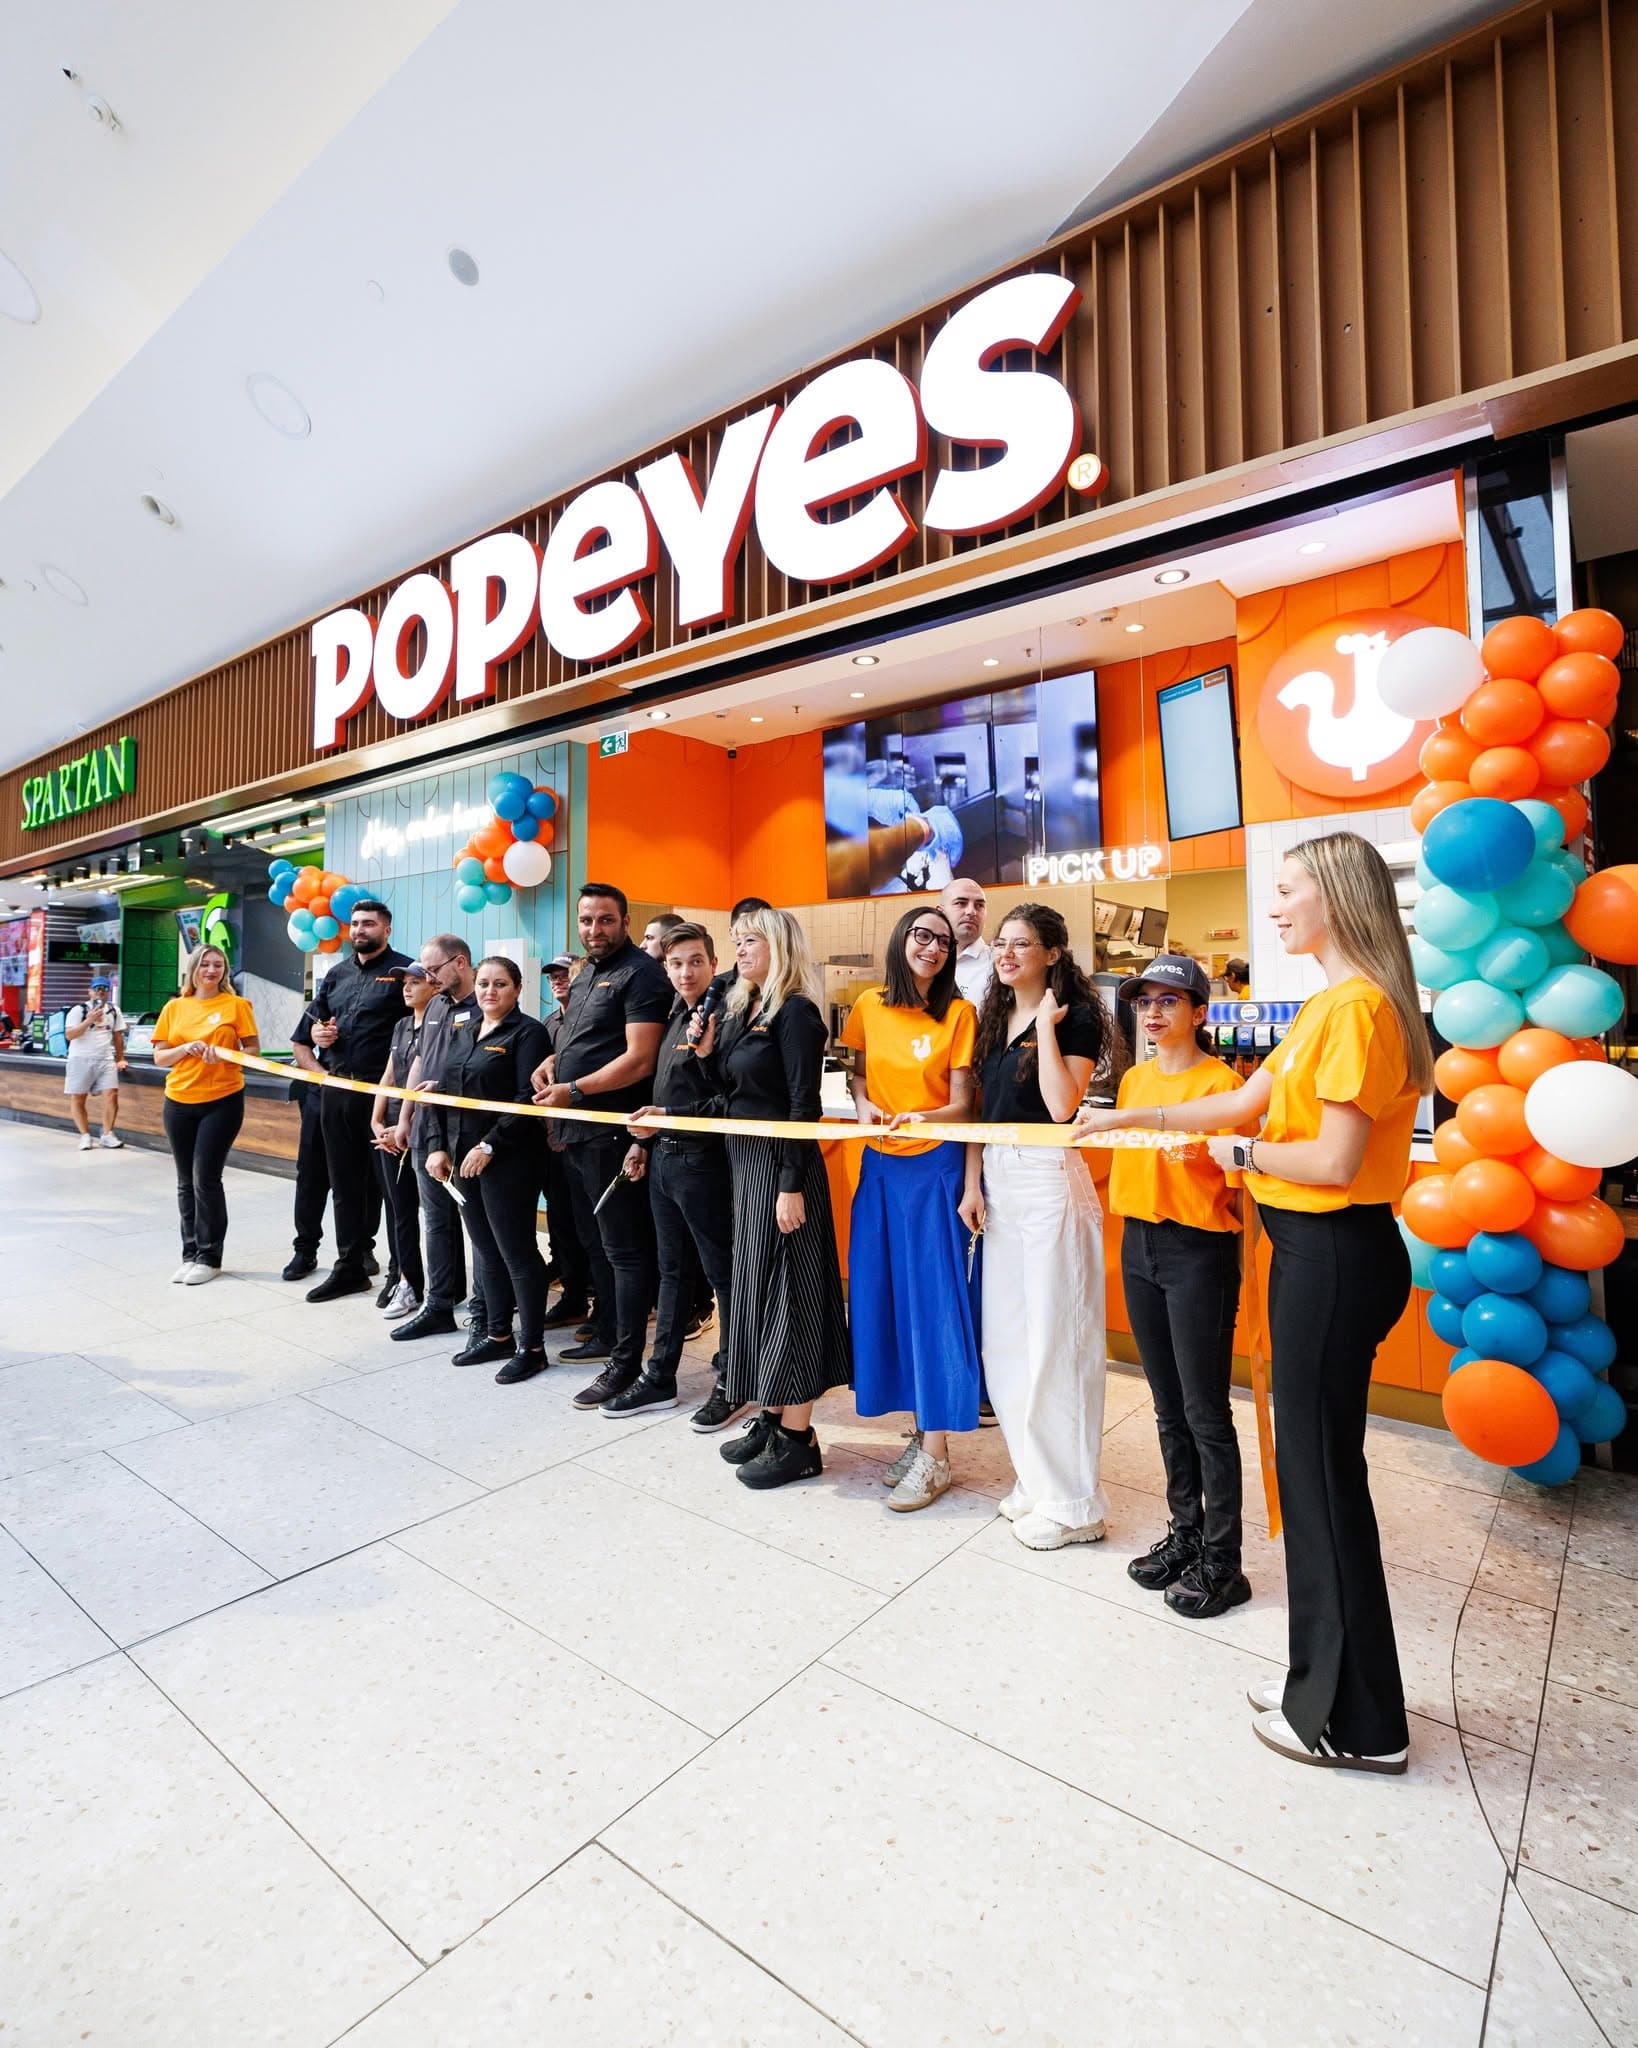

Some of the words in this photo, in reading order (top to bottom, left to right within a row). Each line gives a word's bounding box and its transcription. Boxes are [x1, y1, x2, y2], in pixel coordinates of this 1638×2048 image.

[21, 736, 134, 831] SPARTAN
[1028, 850, 1105, 886] PICK
[1111, 845, 1162, 879] UP
